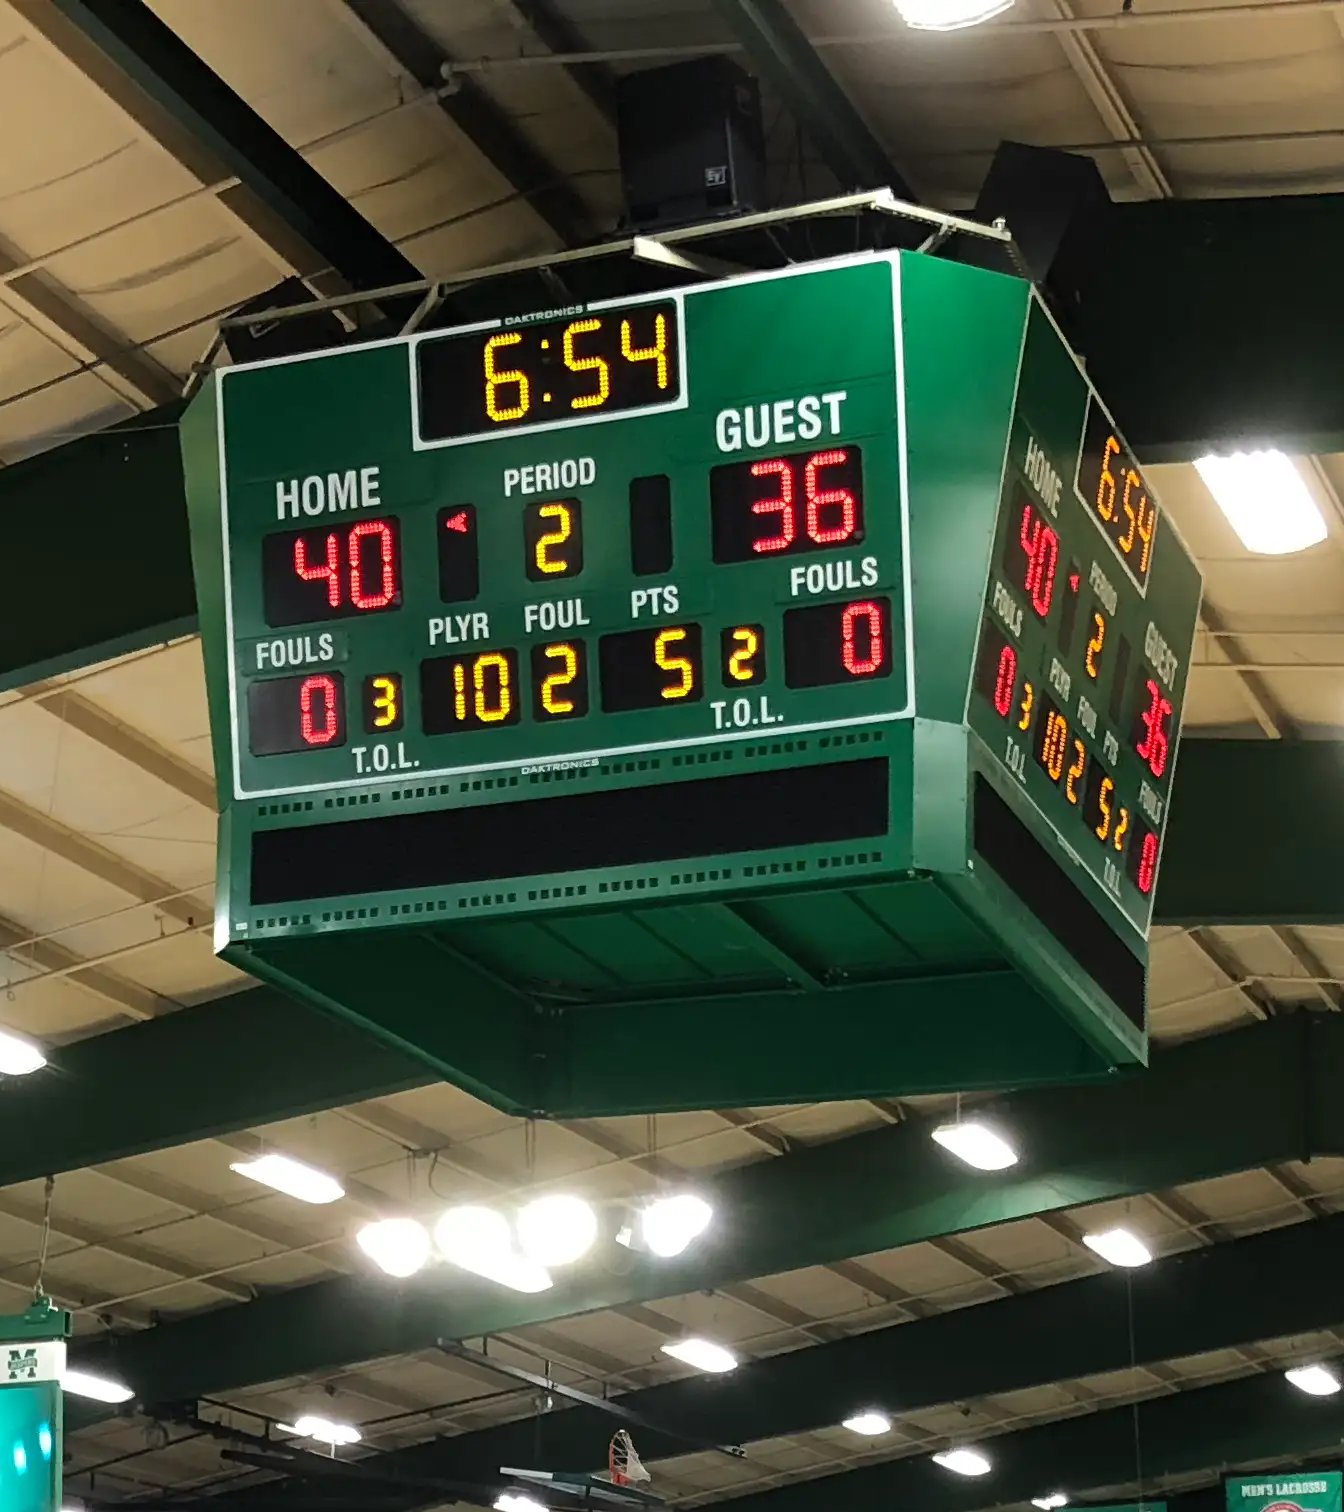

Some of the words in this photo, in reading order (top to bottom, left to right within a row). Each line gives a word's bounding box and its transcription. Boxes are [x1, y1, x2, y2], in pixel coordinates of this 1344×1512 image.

[504, 304, 584, 326] DAKTRONICS
[484, 314, 668, 422] 6:54
[715, 392, 848, 452] GUEST
[276, 468, 381, 519] HOME
[503, 458, 597, 498] PERIOD
[750, 451, 855, 552] 36
[1025, 436, 1063, 518] HOME
[294, 521, 394, 609] 40
[535, 505, 571, 572] 2
[630, 586, 679, 619] PTS
[790, 556, 879, 596] FOULS
[428, 612, 490, 645] PLYR
[524, 598, 590, 633] FOUL
[841, 601, 882, 675] 0
[993, 580, 1024, 638] FOULS
[256, 634, 335, 669] FOULS
[655, 629, 694, 699] 5
[729, 631, 755, 679] 2
[1086, 613, 1104, 678] 2
[372, 678, 397, 727] 3
[454, 653, 510, 722] 10
[541, 644, 577, 712] 2
[996, 646, 1016, 716] 0
[1019, 683, 1032, 730] 3
[300, 676, 336, 744] 0
[710, 698, 784, 730] T.O.L.
[351, 743, 420, 774] T.O.L.
[521, 757, 600, 776] DAKTRONICS
[1066, 739, 1084, 804] 2
[1138, 833, 1158, 892] 0
[1241, 1483, 1273, 1496] MEN'S
[1276, 1480, 1327, 1494] LACROSSE
